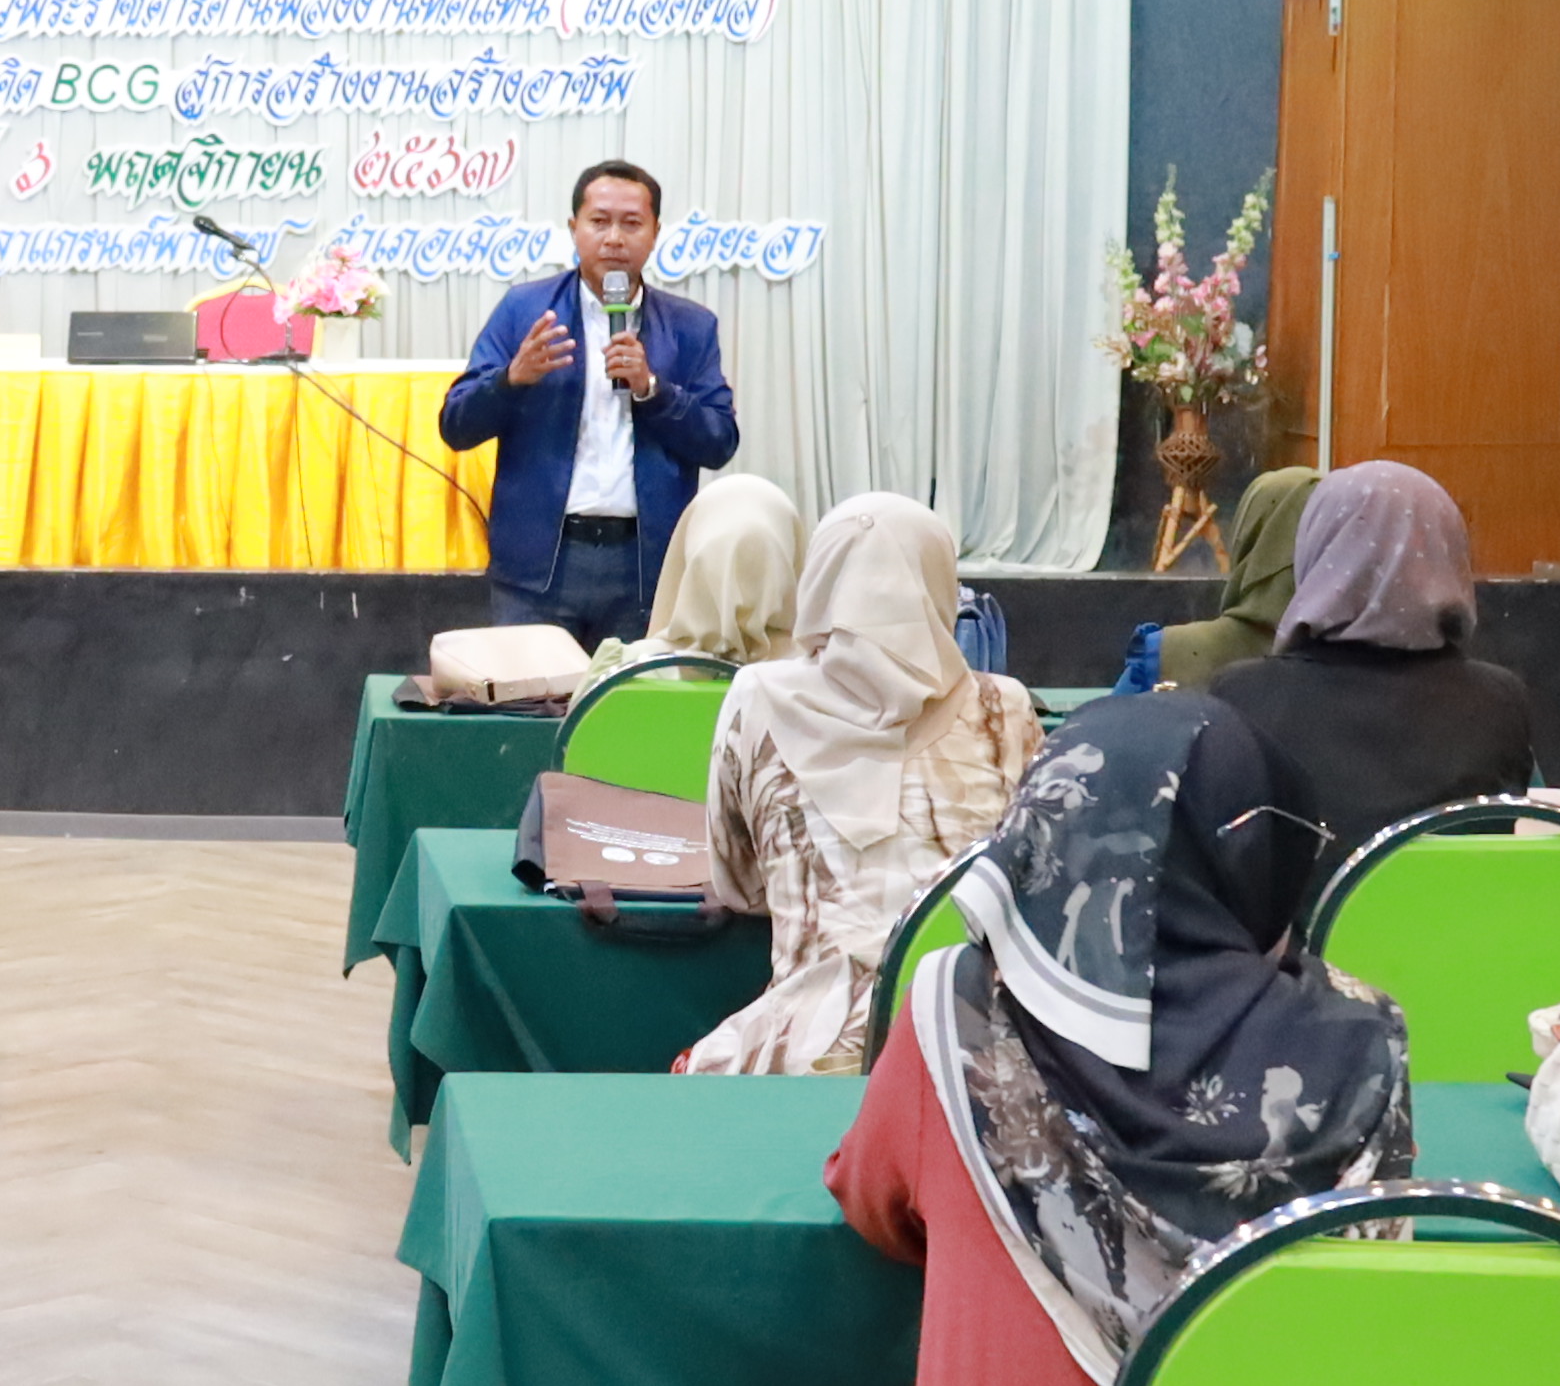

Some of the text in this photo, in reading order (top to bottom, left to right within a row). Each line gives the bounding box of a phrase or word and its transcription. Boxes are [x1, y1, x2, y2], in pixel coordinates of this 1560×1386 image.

[50, 63, 160, 106] BCG
[175, 46, 635, 121] สู่การสร้างงานสร้างอาชีพ
[15, 141, 51, 193] ๖
[87, 132, 324, 208] พฤศจิกายน
[353, 130, 515, 190] ๒๕๖๗
